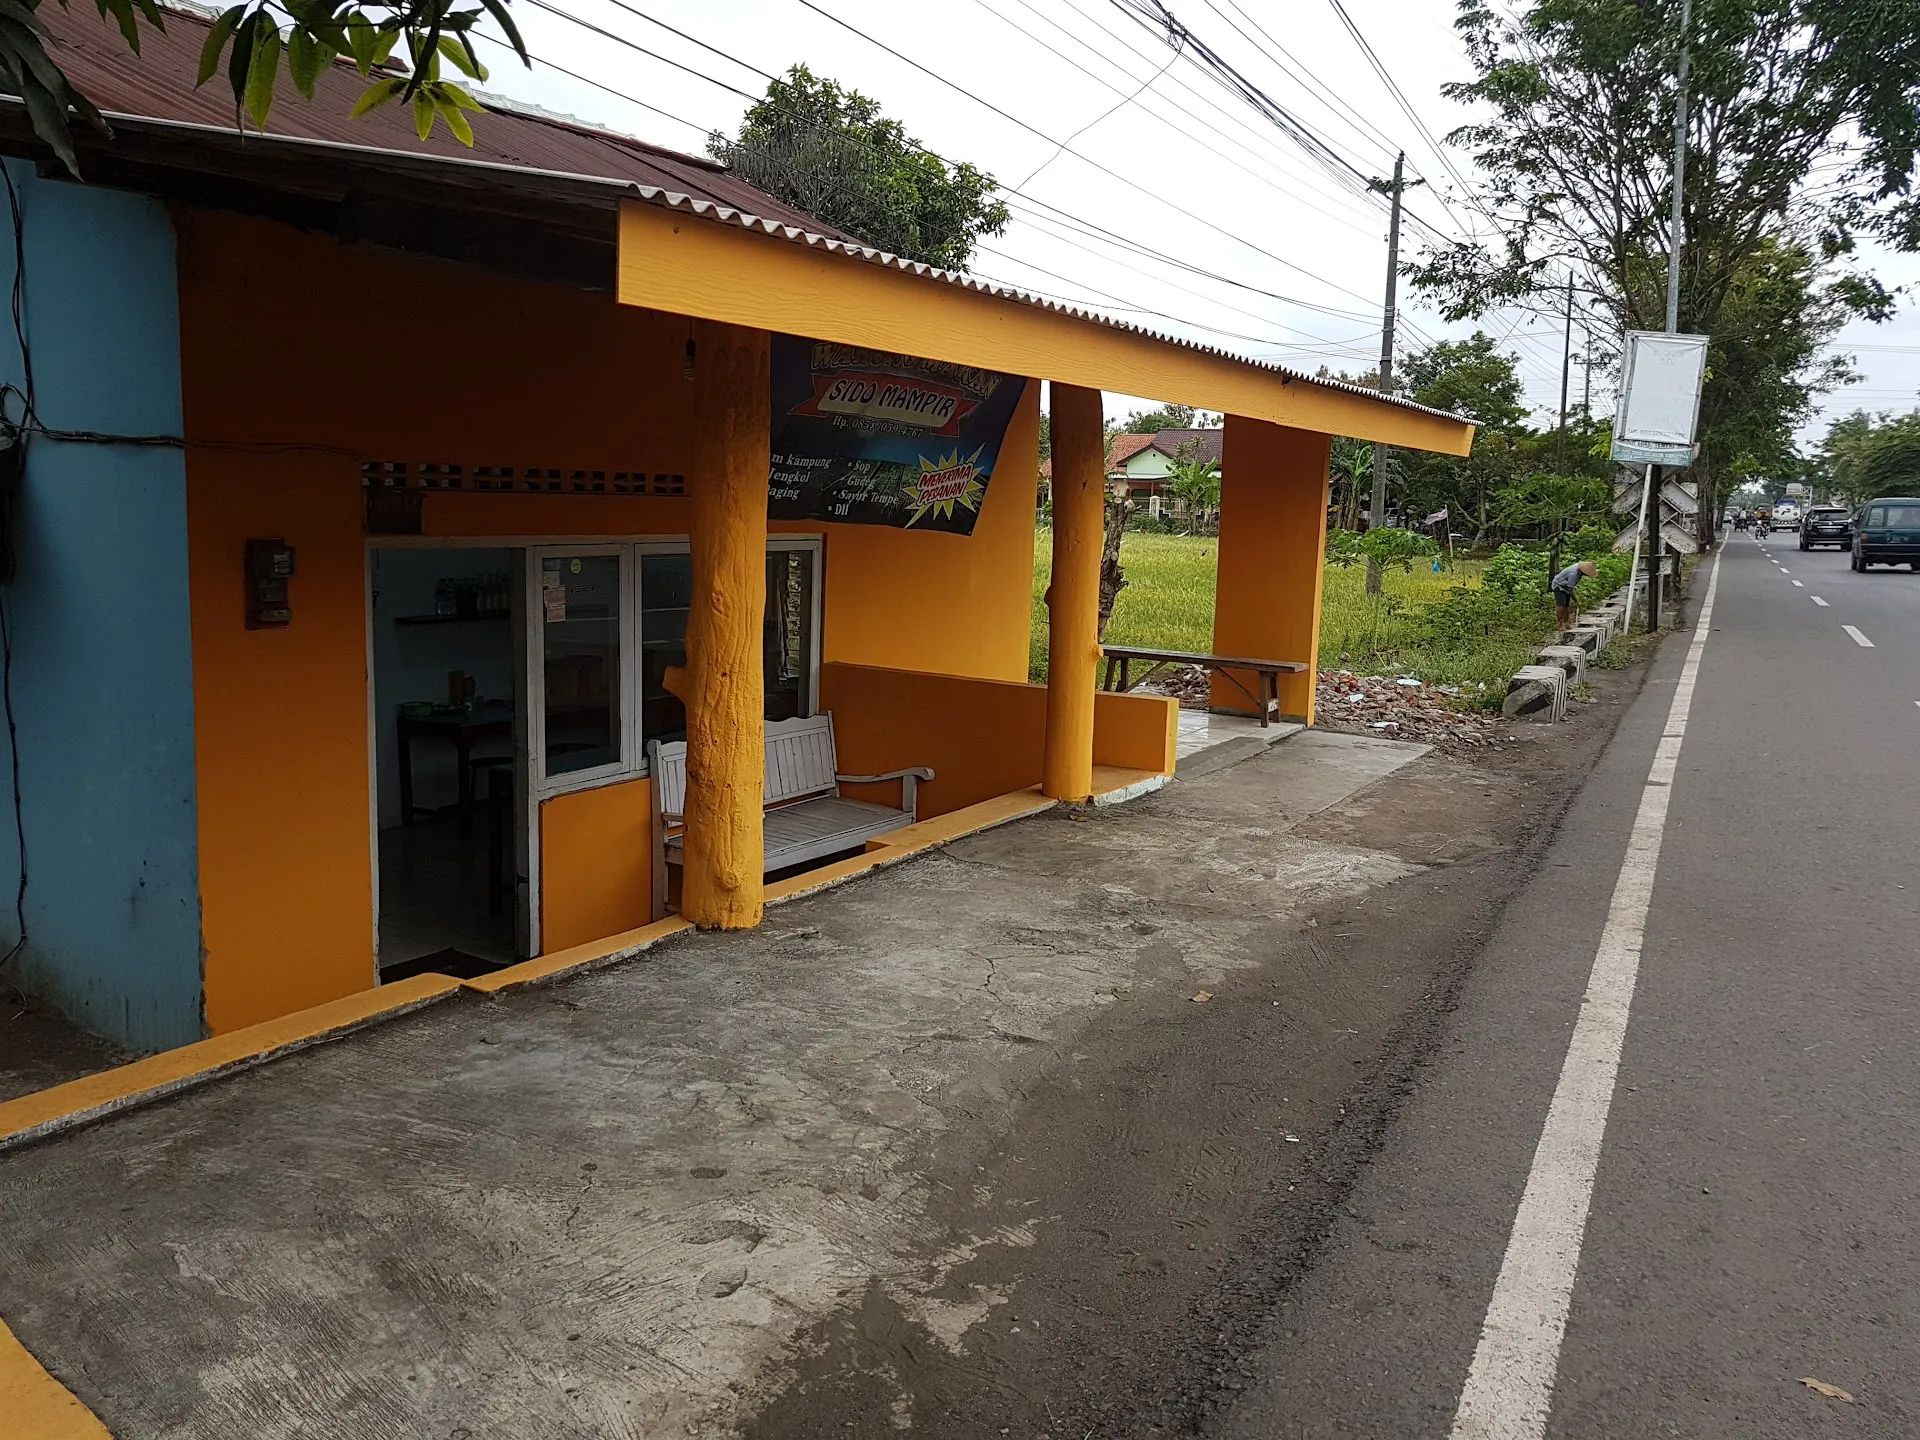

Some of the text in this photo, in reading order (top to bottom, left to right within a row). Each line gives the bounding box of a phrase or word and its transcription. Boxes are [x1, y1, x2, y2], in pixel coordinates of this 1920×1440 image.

[829, 379, 956, 418] SIDO MAMPIR
[786, 454, 832, 470] kampung
[854, 460, 870, 474] Sop
[847, 475, 876, 489] Gudeg
[918, 464, 973, 490] MENERIMA
[769, 484, 800, 500] aging
[838, 489, 899, 506] Sayur Tempe
[917, 482, 967, 506] PESANAN
